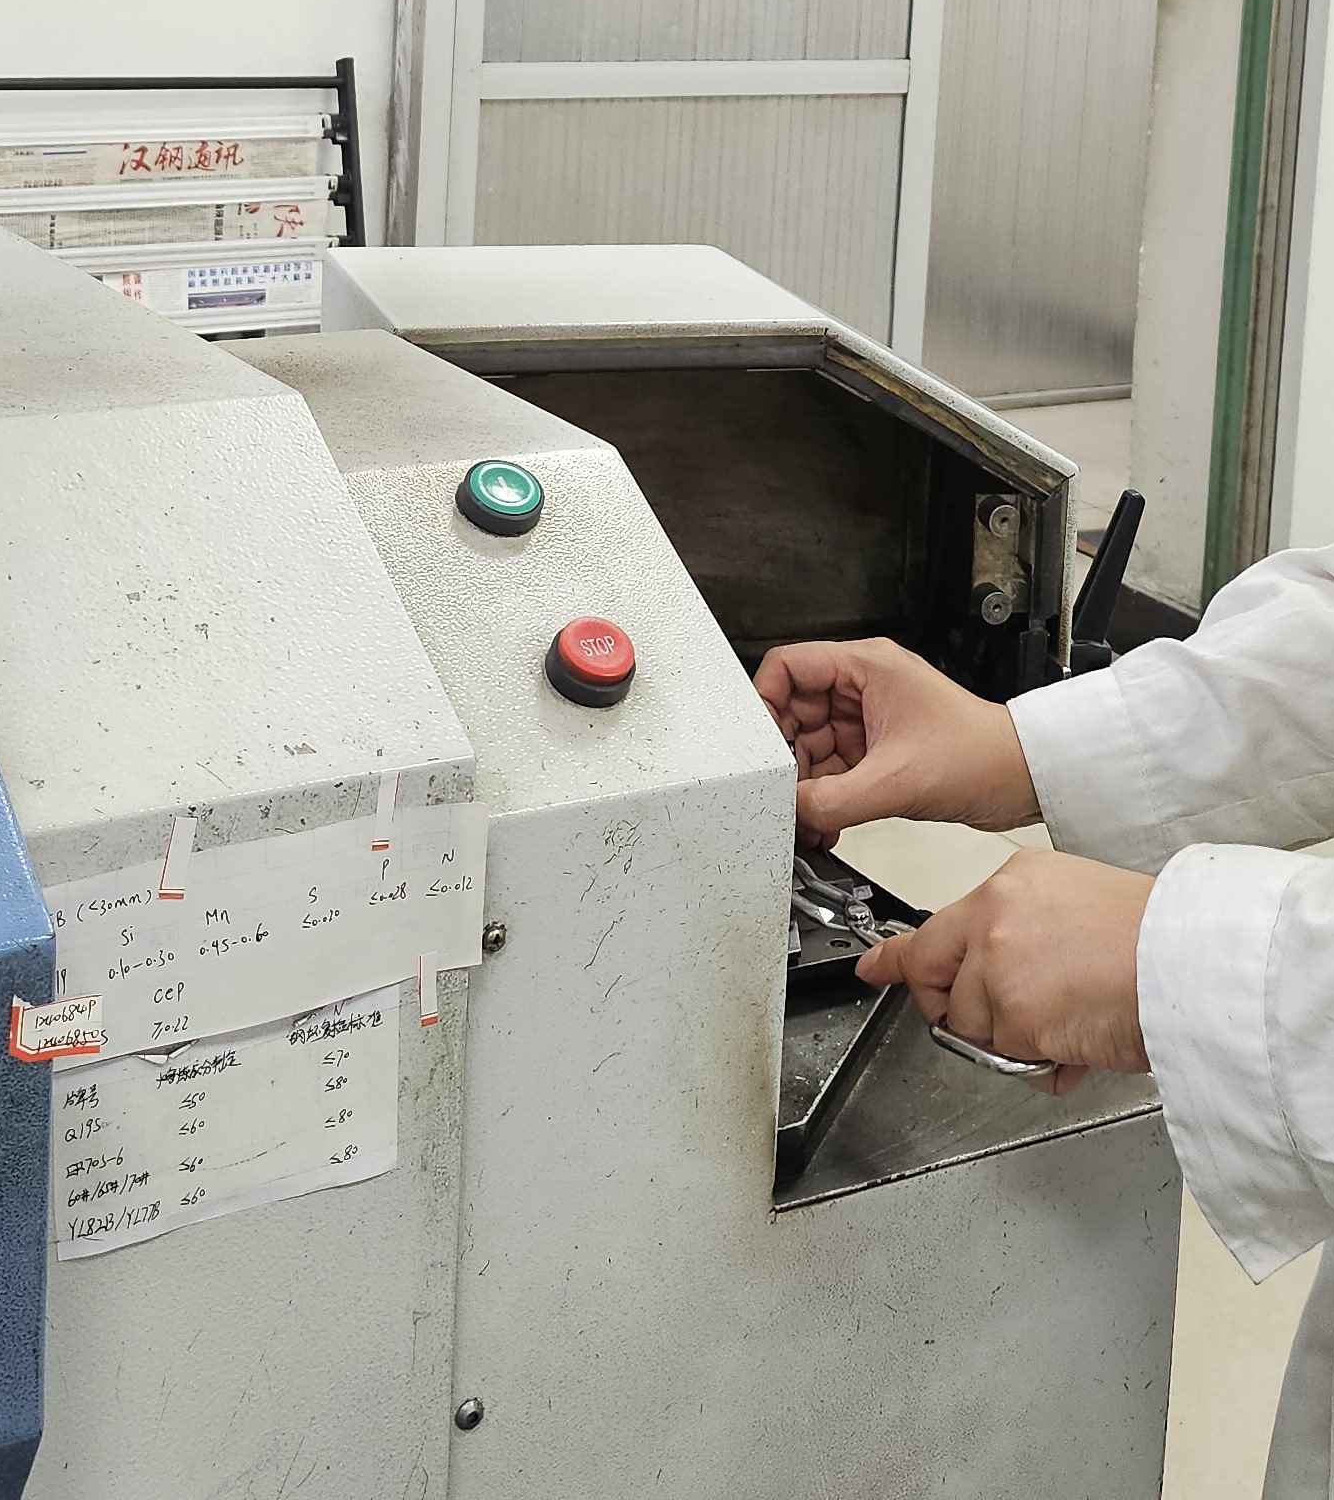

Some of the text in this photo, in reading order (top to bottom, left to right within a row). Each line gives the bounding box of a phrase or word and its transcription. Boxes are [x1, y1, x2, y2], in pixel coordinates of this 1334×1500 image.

[119, 139, 245, 176] 汉钢通讯
[579, 634, 615, 658] STOP
[121, 849, 455, 946] Si Mn S P N
